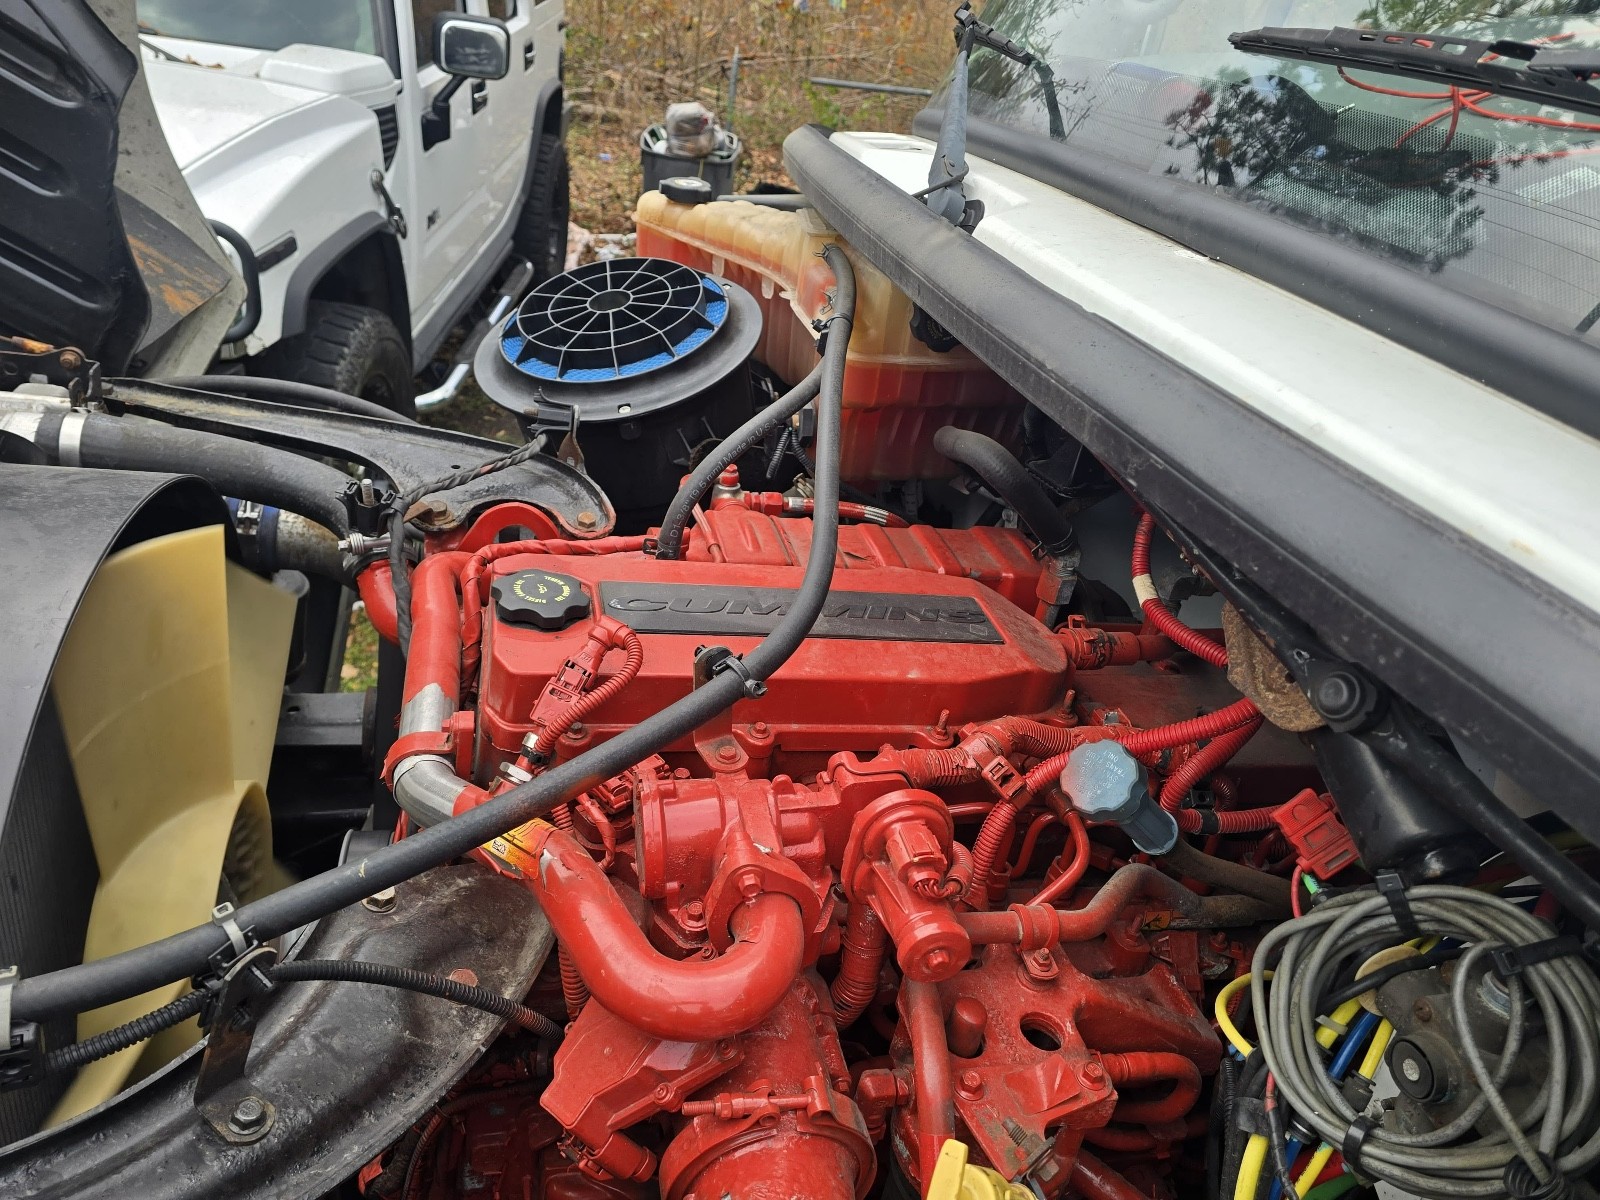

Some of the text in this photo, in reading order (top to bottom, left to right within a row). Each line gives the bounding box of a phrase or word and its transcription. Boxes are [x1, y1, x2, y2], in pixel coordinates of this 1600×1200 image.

[723, 443, 747, 465] Made
[746, 435, 757, 448] in
[608, 597, 987, 624] CUMMINS
[1105, 761, 1126, 778] TRANS
